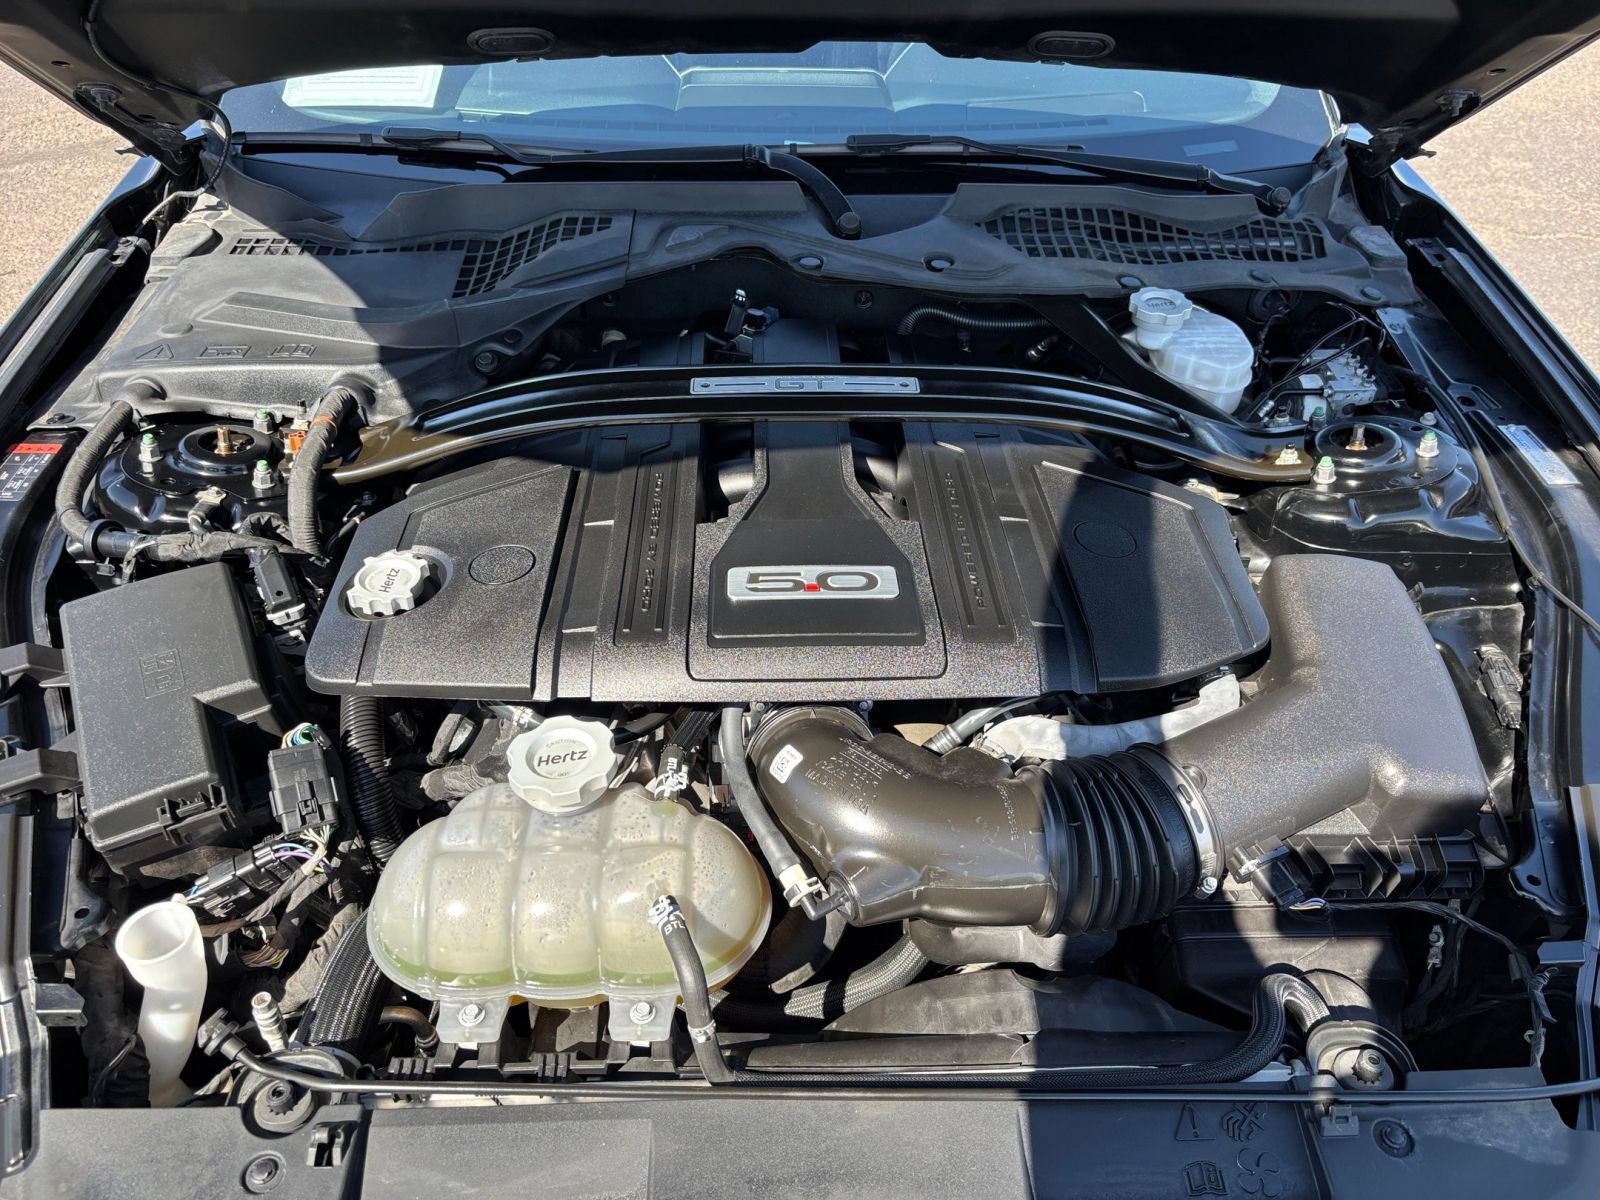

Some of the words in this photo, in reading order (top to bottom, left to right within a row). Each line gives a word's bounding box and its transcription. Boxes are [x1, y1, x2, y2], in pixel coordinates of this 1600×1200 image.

[774, 377, 835, 391] GT
[650, 472, 665, 540] POWERED
[646, 543, 658, 561] BY
[378, 568, 401, 593] Hertz
[641, 568, 655, 612] FORD
[745, 571, 881, 593] 5.0
[537, 750, 589, 767] Hertz
[664, 920, 685, 936] BTL
